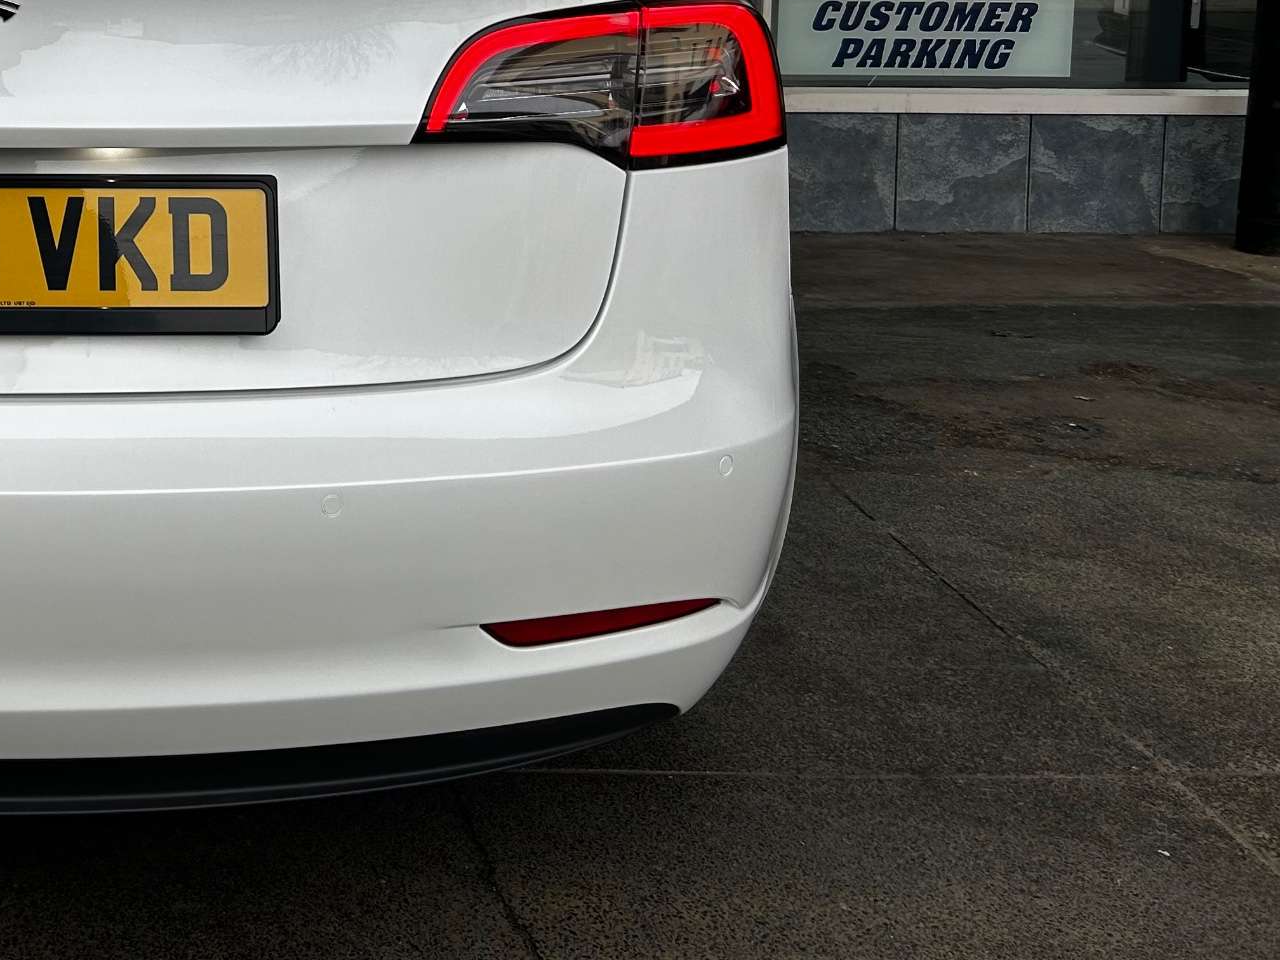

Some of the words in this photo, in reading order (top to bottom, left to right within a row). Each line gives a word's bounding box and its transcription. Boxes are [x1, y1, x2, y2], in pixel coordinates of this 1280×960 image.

[812, 0, 1039, 33] CUSTOMER
[831, 38, 1016, 70] PARKING
[27, 196, 230, 292] VKD
